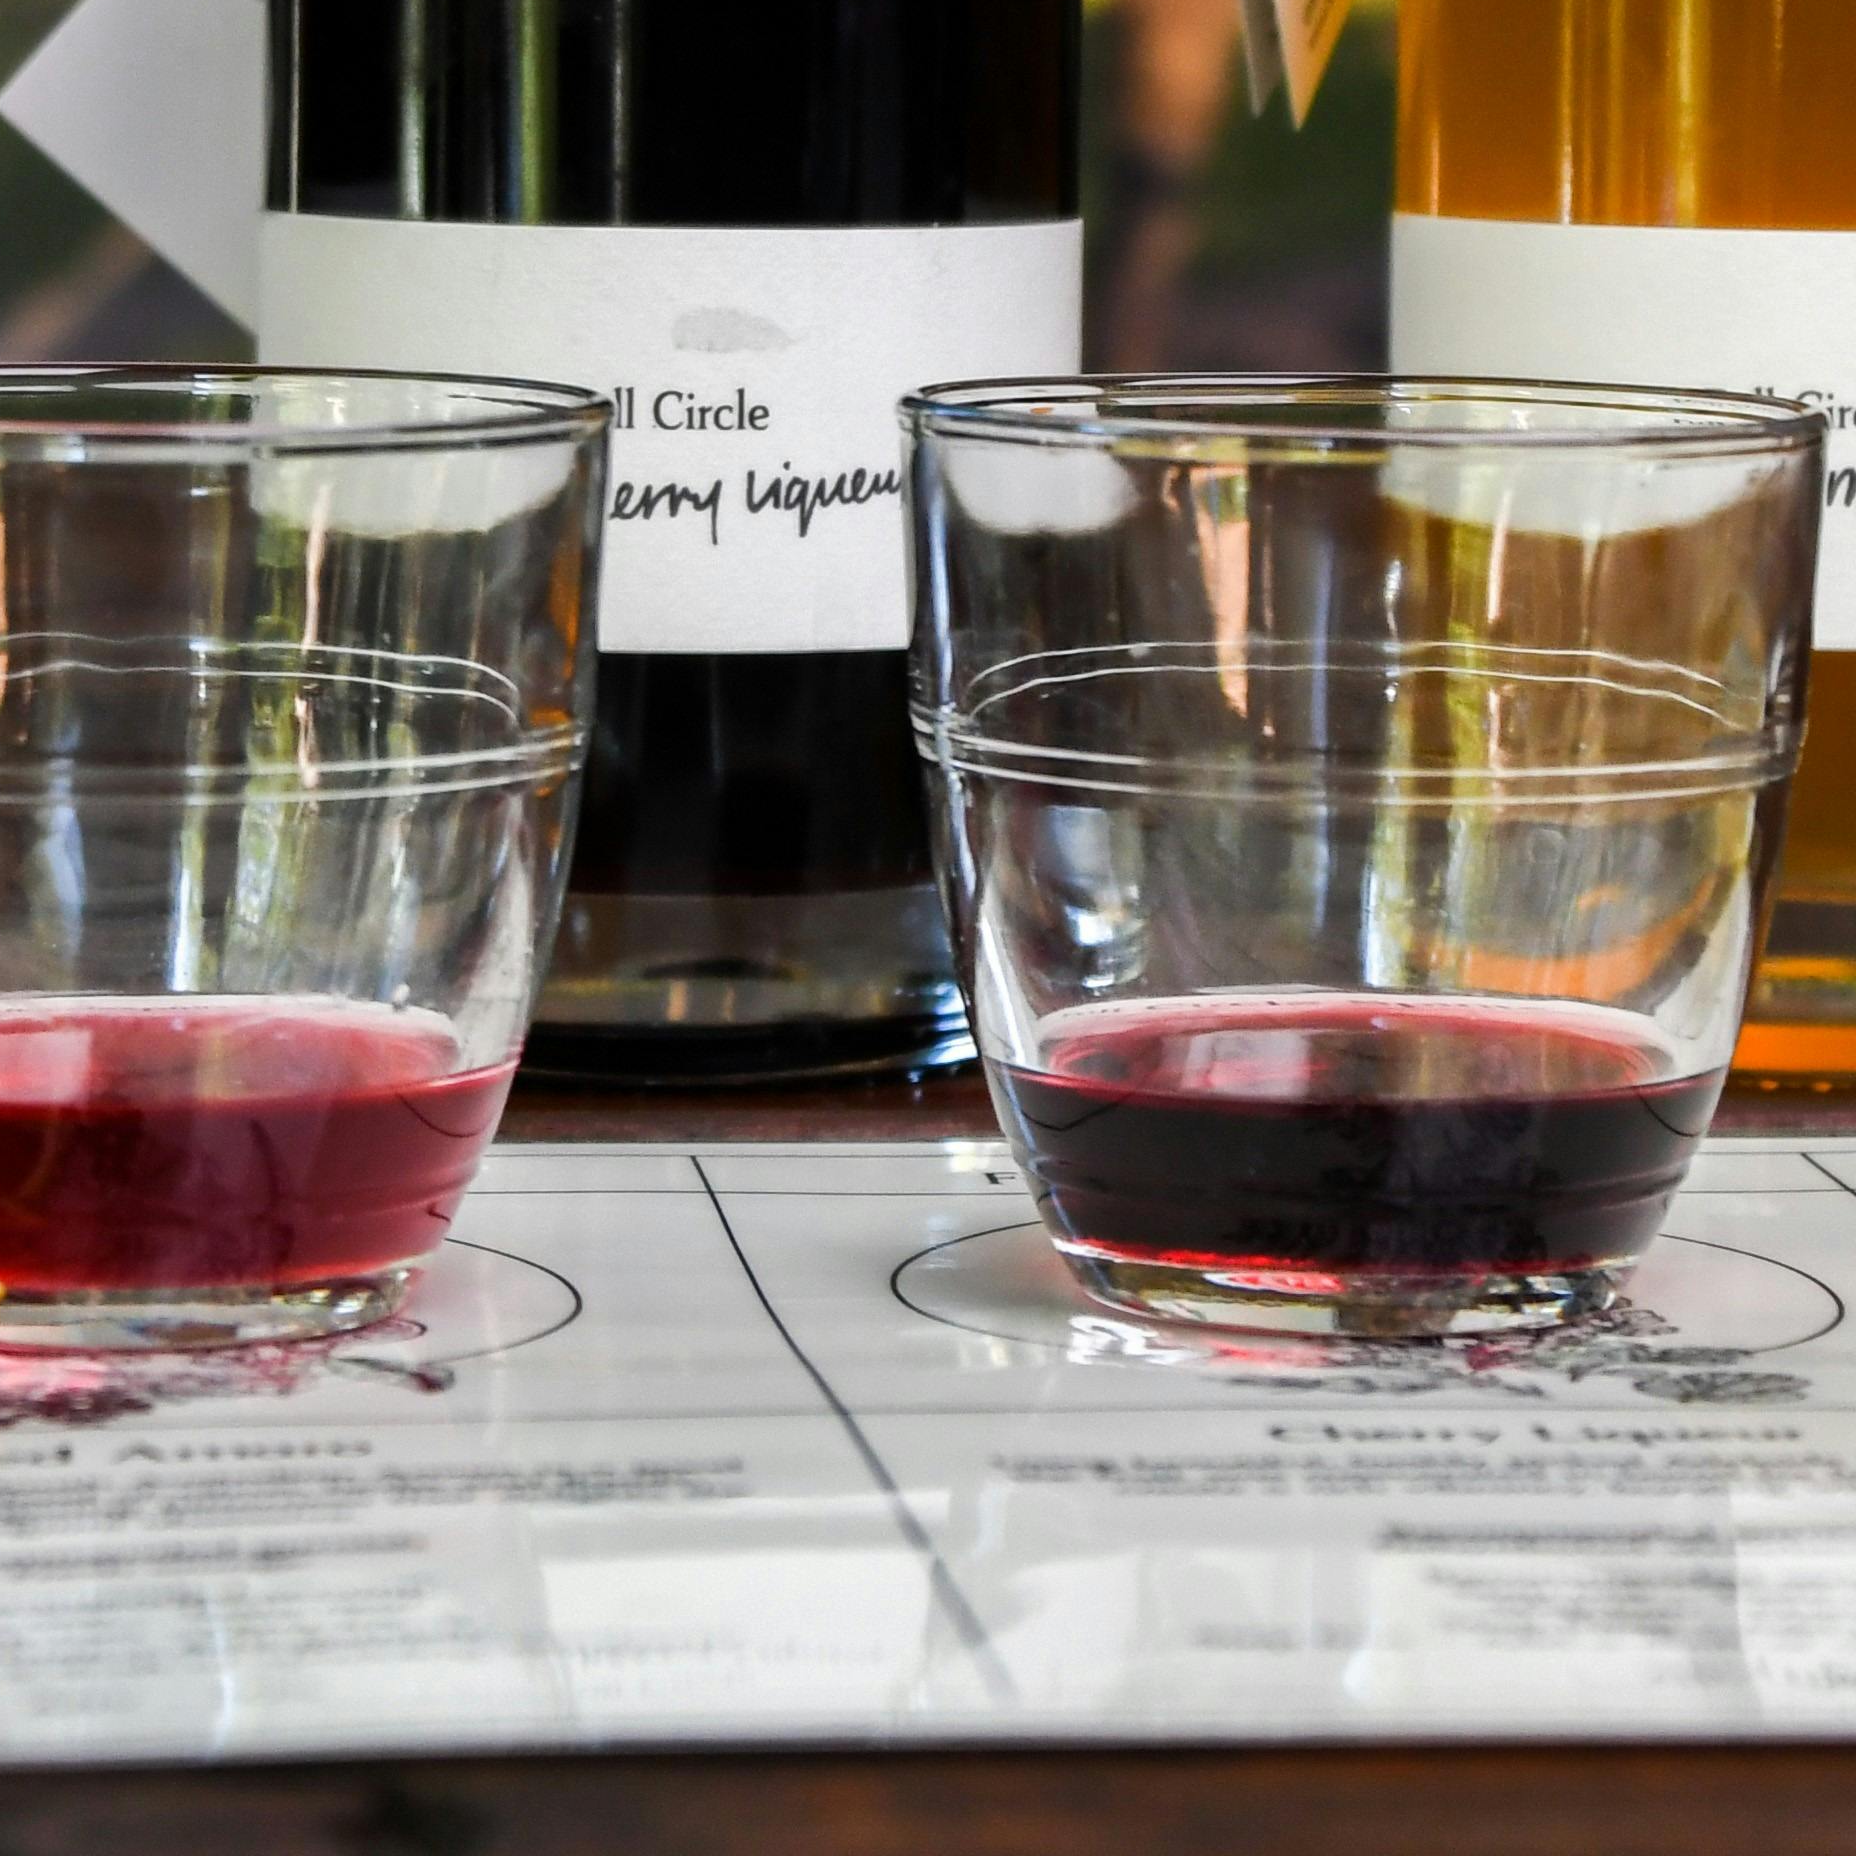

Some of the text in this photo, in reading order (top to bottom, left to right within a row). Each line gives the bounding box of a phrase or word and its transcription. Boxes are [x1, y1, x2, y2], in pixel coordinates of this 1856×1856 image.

[614, 387, 770, 431] ll Circle
[610, 462, 901, 545] erry Liqueu
